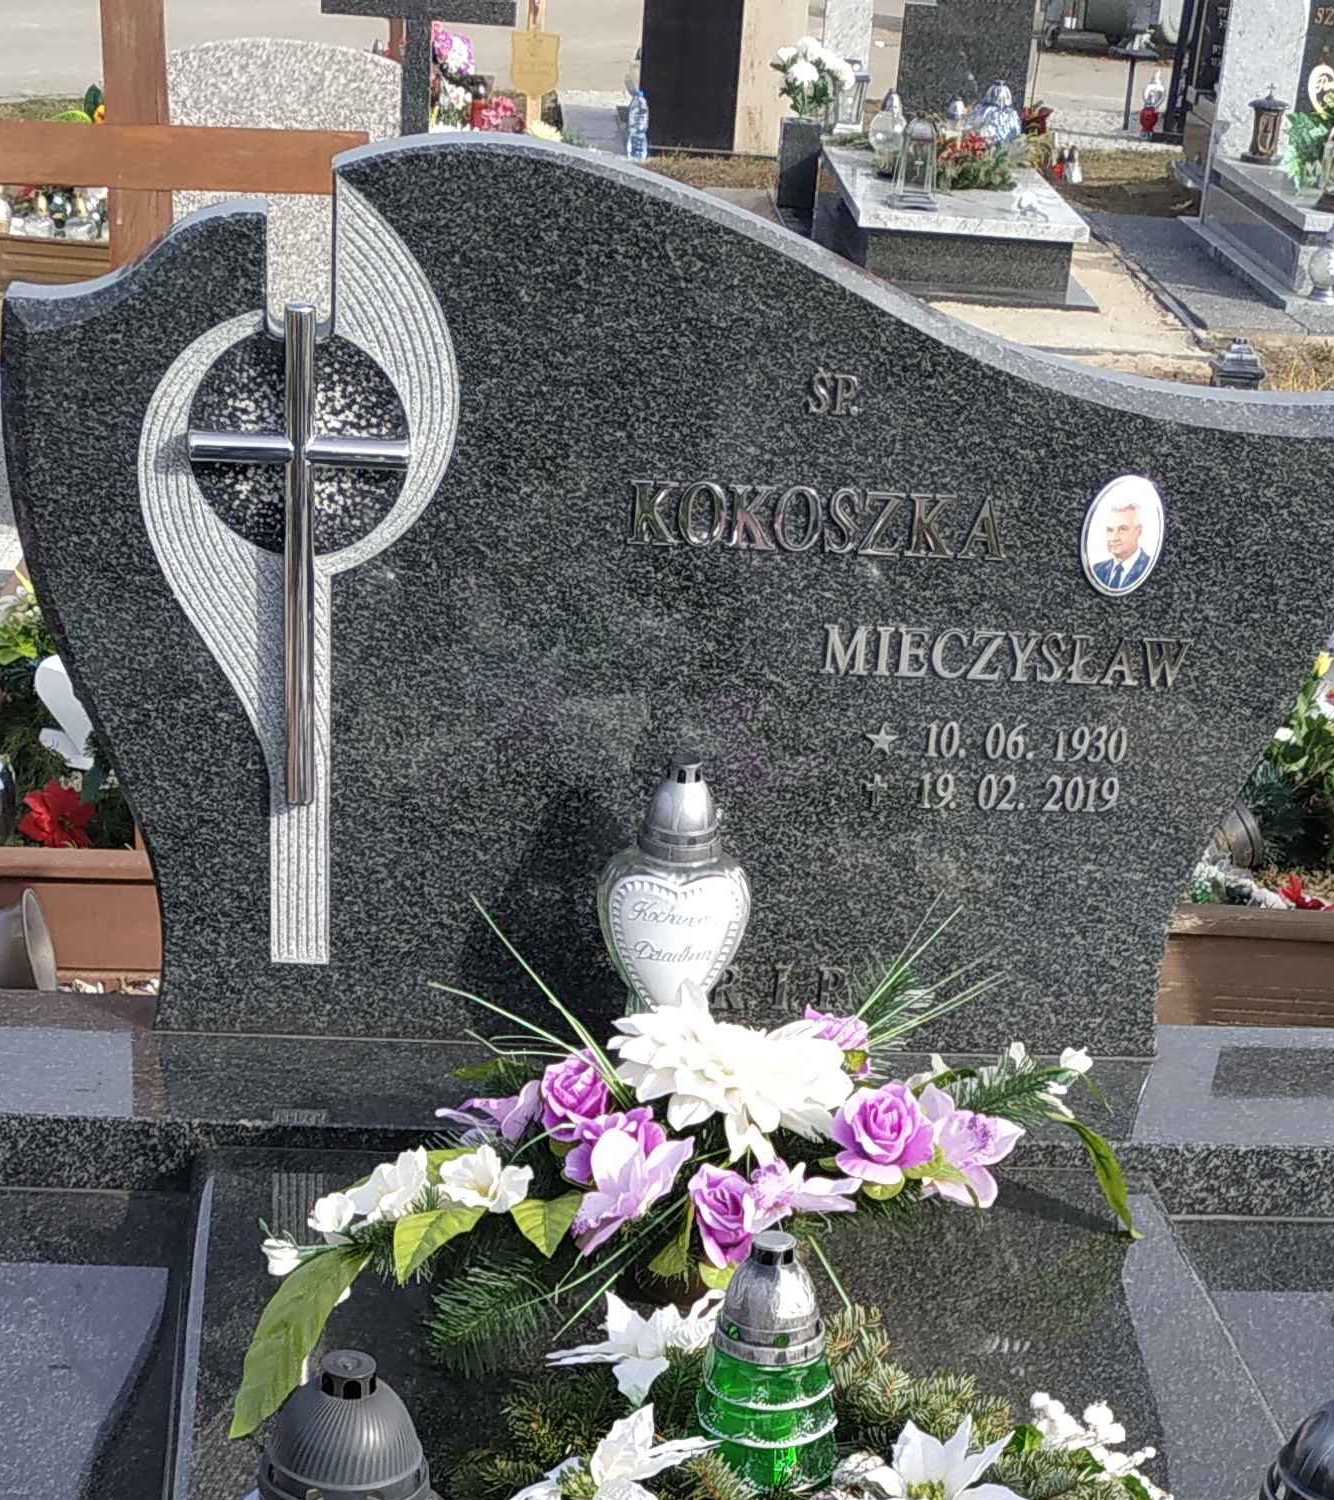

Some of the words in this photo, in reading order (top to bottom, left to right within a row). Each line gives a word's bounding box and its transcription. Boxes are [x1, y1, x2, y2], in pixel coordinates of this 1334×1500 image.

[626, 479, 1006, 562] KOKOSZKA
[819, 623, 1195, 688] MIECZYSŁAW
[923, 719, 967, 760] 10.
[985, 721, 1035, 762] 06.
[1052, 724, 1128, 764] 1930
[920, 771, 958, 811] 19.
[977, 772, 1025, 812] 02.
[1042, 774, 1120, 813] 2019
